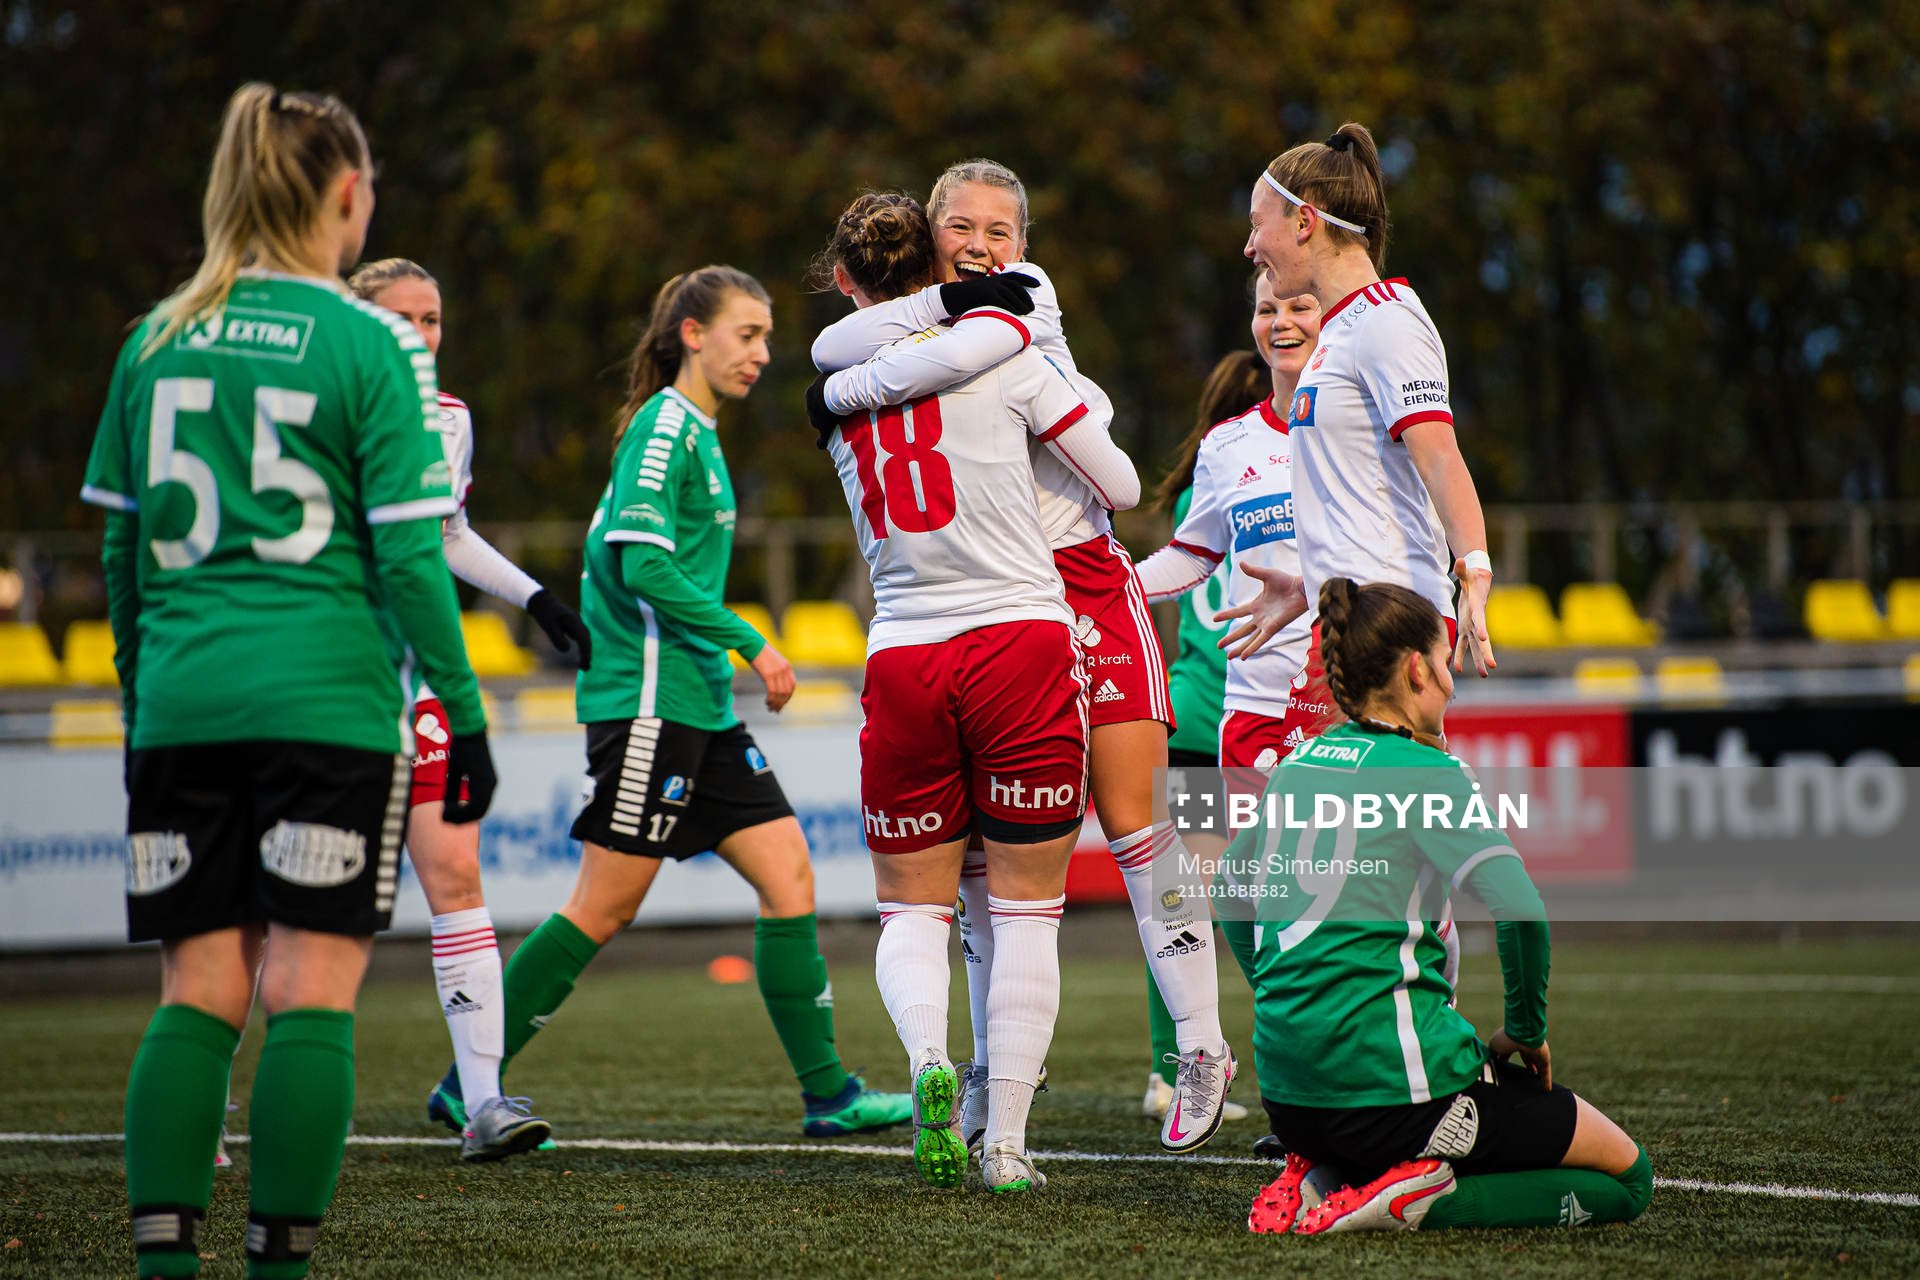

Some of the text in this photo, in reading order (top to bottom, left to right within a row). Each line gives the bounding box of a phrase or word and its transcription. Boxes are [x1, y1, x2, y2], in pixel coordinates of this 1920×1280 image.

[225, 318, 299, 349] EXTRA
[147, 376, 335, 571] 55
[838, 391, 957, 541] 18
[1235, 500, 1294, 532] SpareB
[1261, 521, 1295, 536] NORD
[1098, 653, 1133, 665] kraft
[1297, 699, 1328, 715] kraft
[1310, 744, 1359, 763] EXTRA
[990, 776, 1074, 809] ht.no
[646, 812, 678, 843] 17
[864, 805, 943, 838] ht.no
[1165, 920, 1194, 932] Maskin
[1157, 939, 1207, 958] adidas
